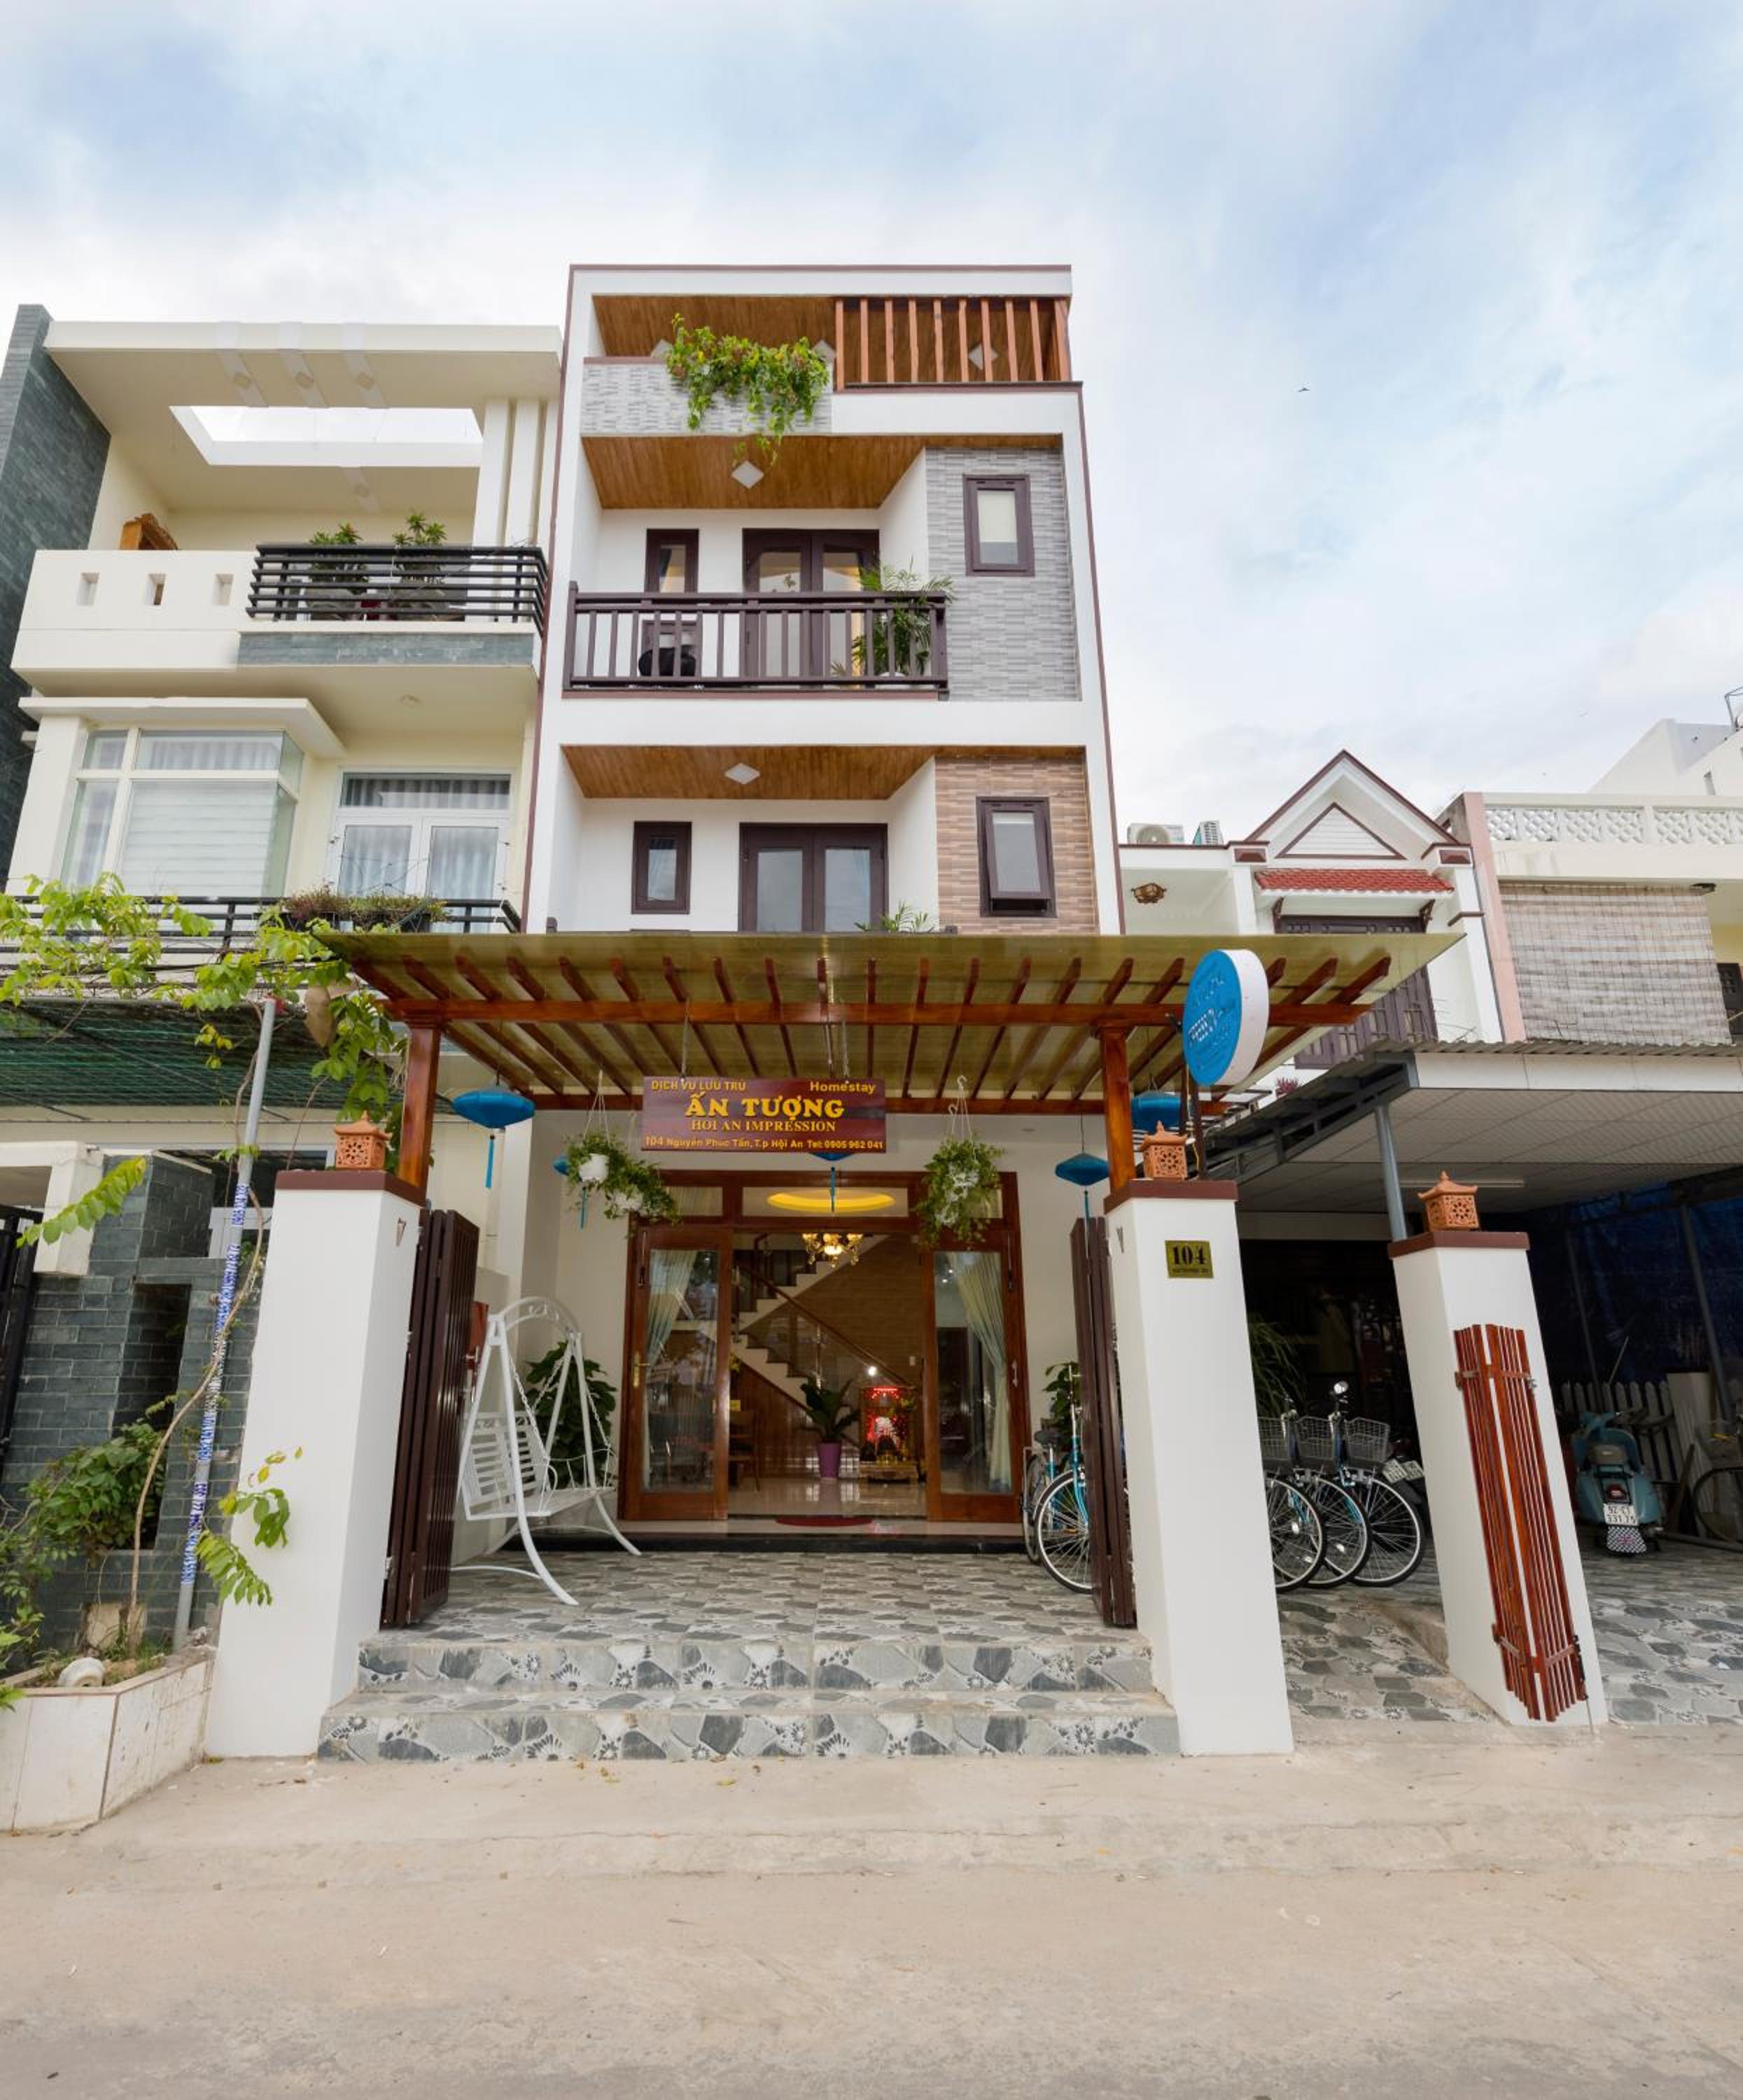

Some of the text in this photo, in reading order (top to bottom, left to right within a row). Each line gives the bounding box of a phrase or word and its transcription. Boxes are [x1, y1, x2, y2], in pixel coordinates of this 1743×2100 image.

[809, 1080, 876, 1095] Homestay
[684, 1091, 845, 1121] ẤN TƯỢNG
[722, 1119, 742, 1130] AN
[745, 1119, 836, 1130] IMPRESSION
[645, 1135, 664, 1147] 104
[790, 1139, 804, 1149] An
[1172, 1246, 1207, 1265] 104
